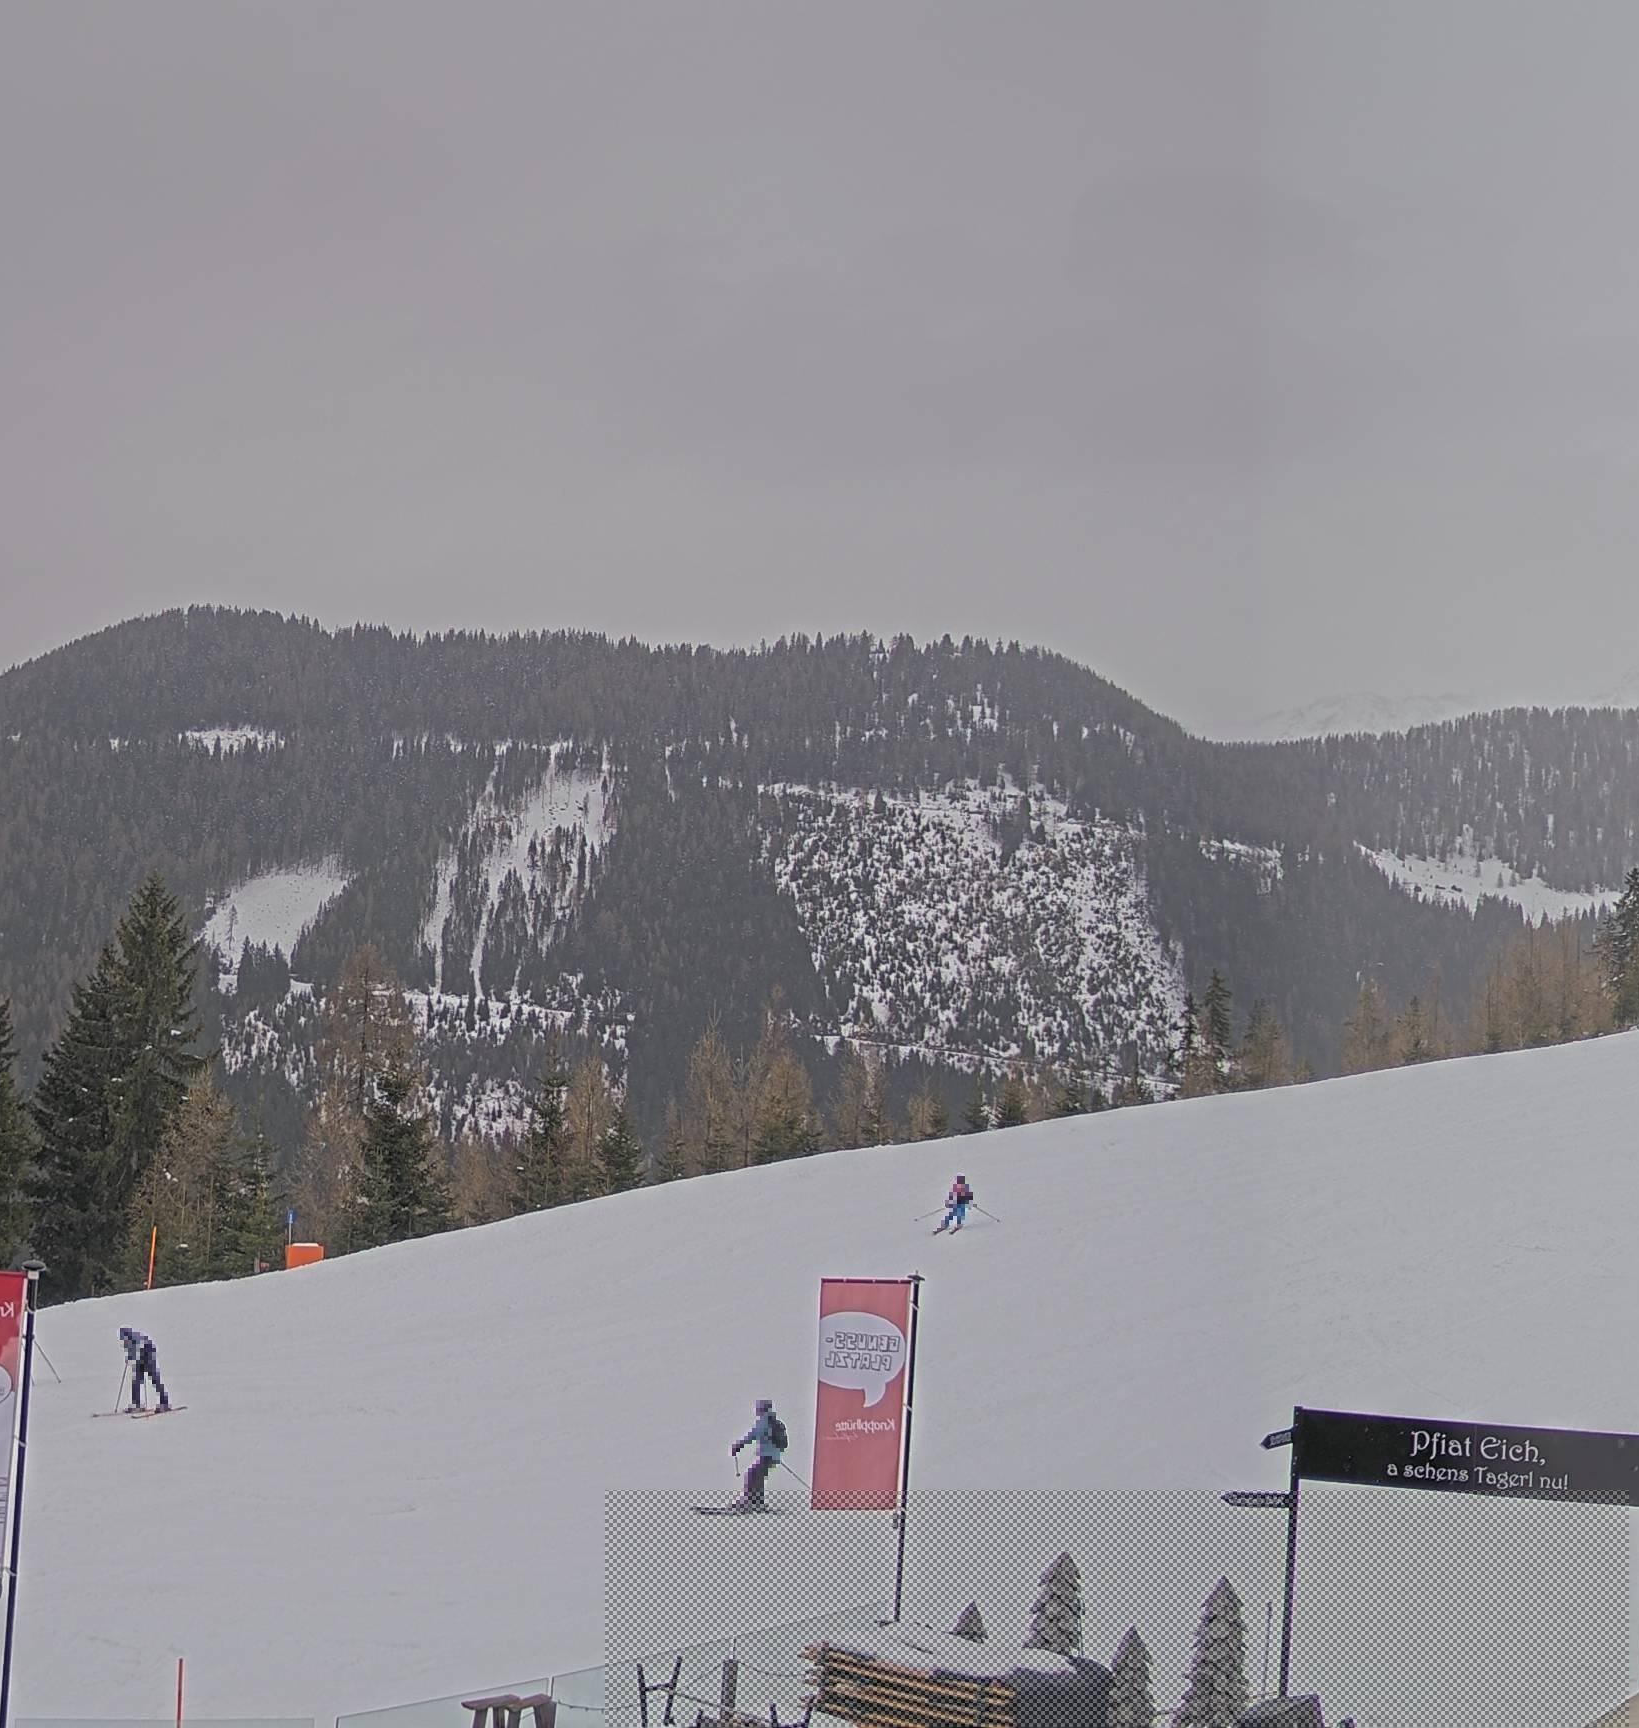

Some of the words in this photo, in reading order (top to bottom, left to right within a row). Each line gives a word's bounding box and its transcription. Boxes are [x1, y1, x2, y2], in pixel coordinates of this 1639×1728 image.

[1410, 1430, 1472, 1460] Pfiat
[1480, 1436, 1546, 1466] Eich,
[1387, 1463, 1398, 1476] a
[1403, 1462, 1469, 1482] schens
[1474, 1466, 1534, 1490] Tagerl
[1539, 1473, 1569, 1490] nu!
